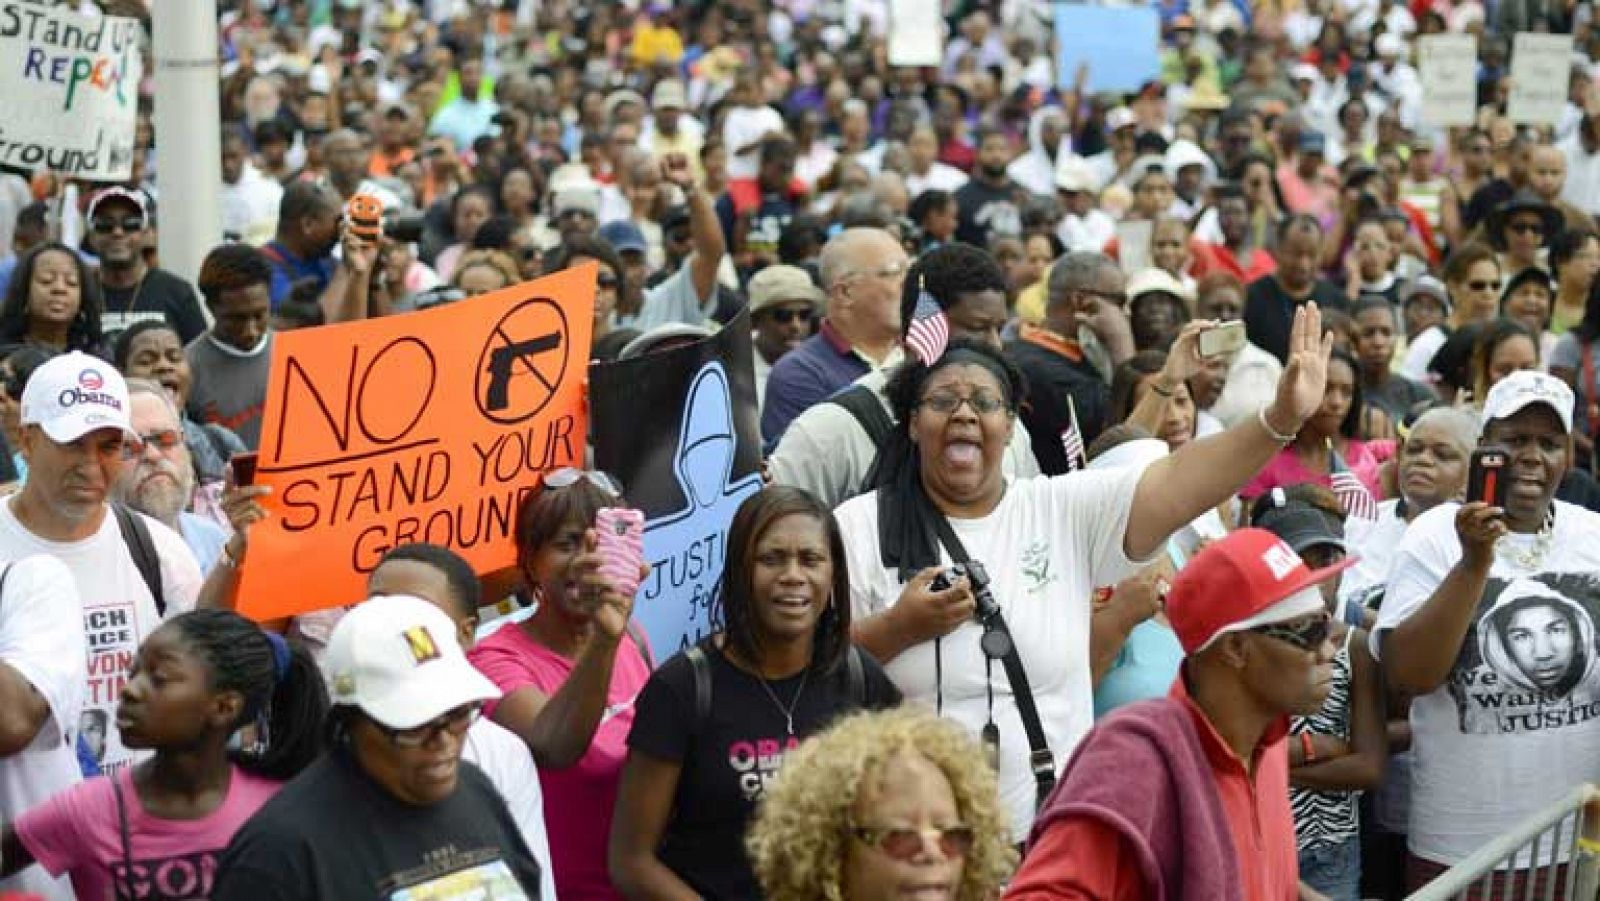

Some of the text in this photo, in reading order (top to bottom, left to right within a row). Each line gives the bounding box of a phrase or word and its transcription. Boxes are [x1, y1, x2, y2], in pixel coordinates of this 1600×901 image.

[0, 127, 103, 172] round
[57, 386, 121, 411] Obama
[274, 336, 437, 464] NO
[280, 415, 574, 532] STAND YOUR
[352, 487, 532, 574] GROUN
[83, 609, 126, 630] CH
